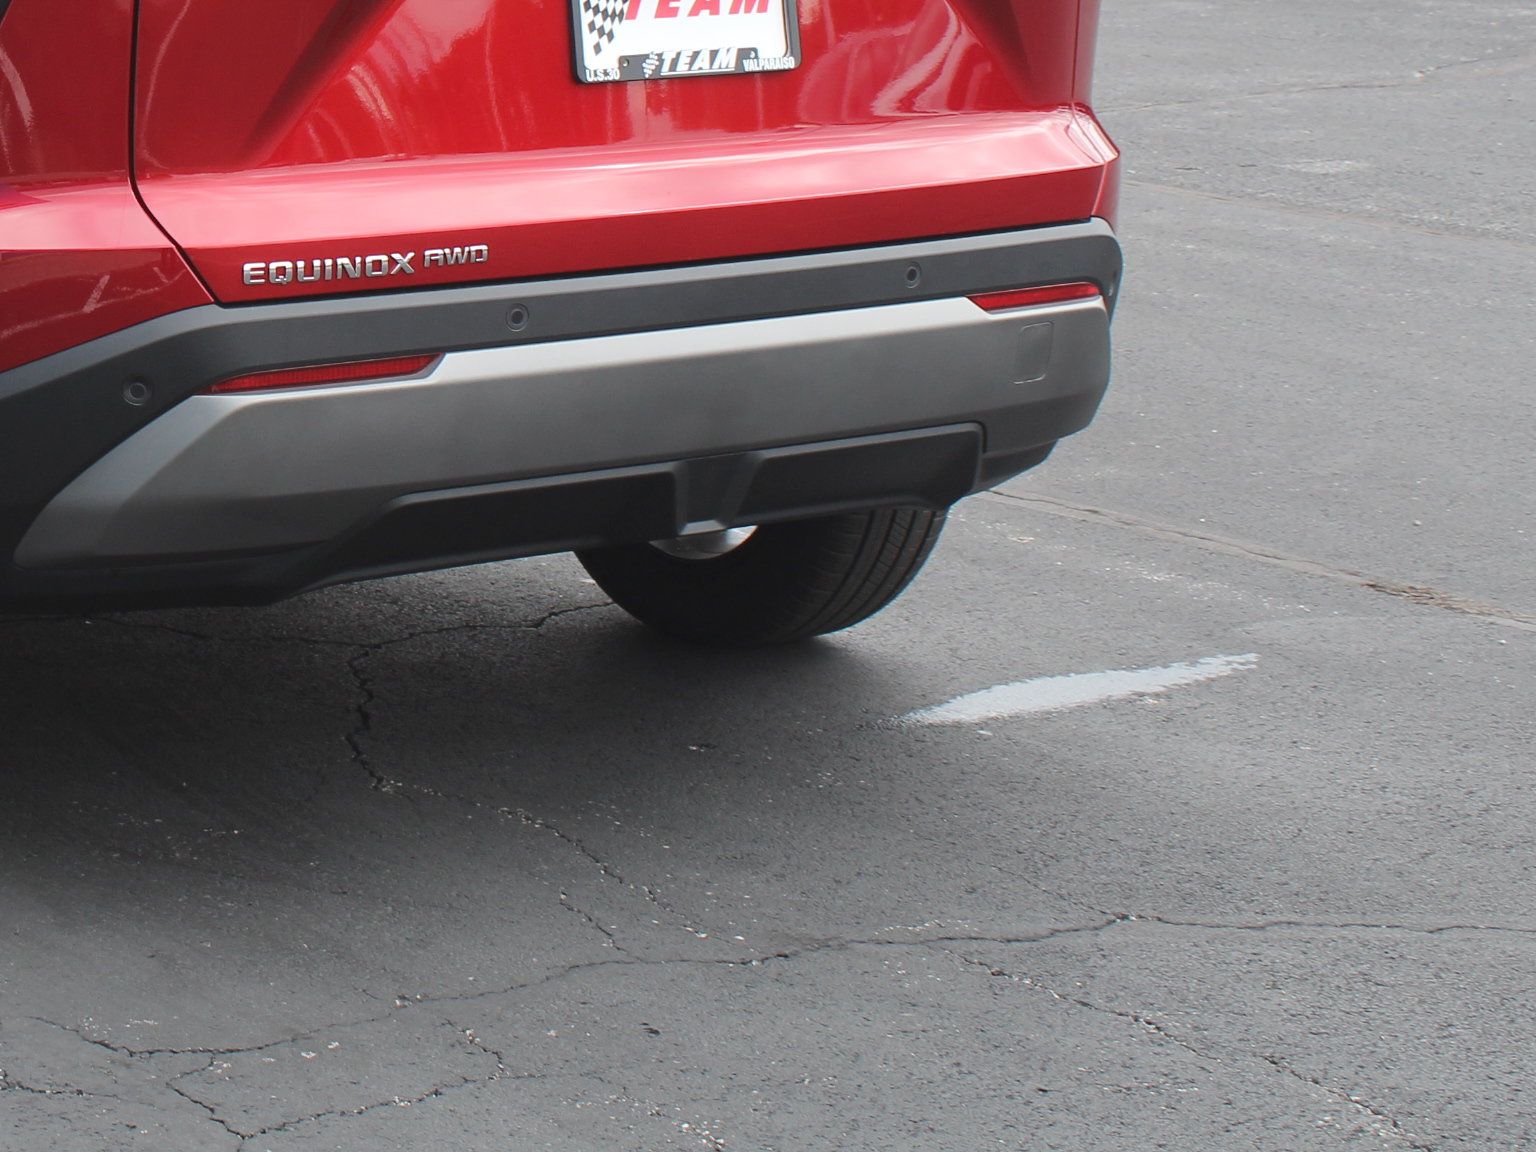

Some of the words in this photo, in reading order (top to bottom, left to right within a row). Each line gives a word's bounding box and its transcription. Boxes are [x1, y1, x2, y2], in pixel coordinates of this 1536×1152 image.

[661, 47, 739, 74] TEAM
[742, 56, 795, 72] VALPARAISO
[242, 252, 416, 285] EQUINOX
[423, 244, 489, 268] AWD
